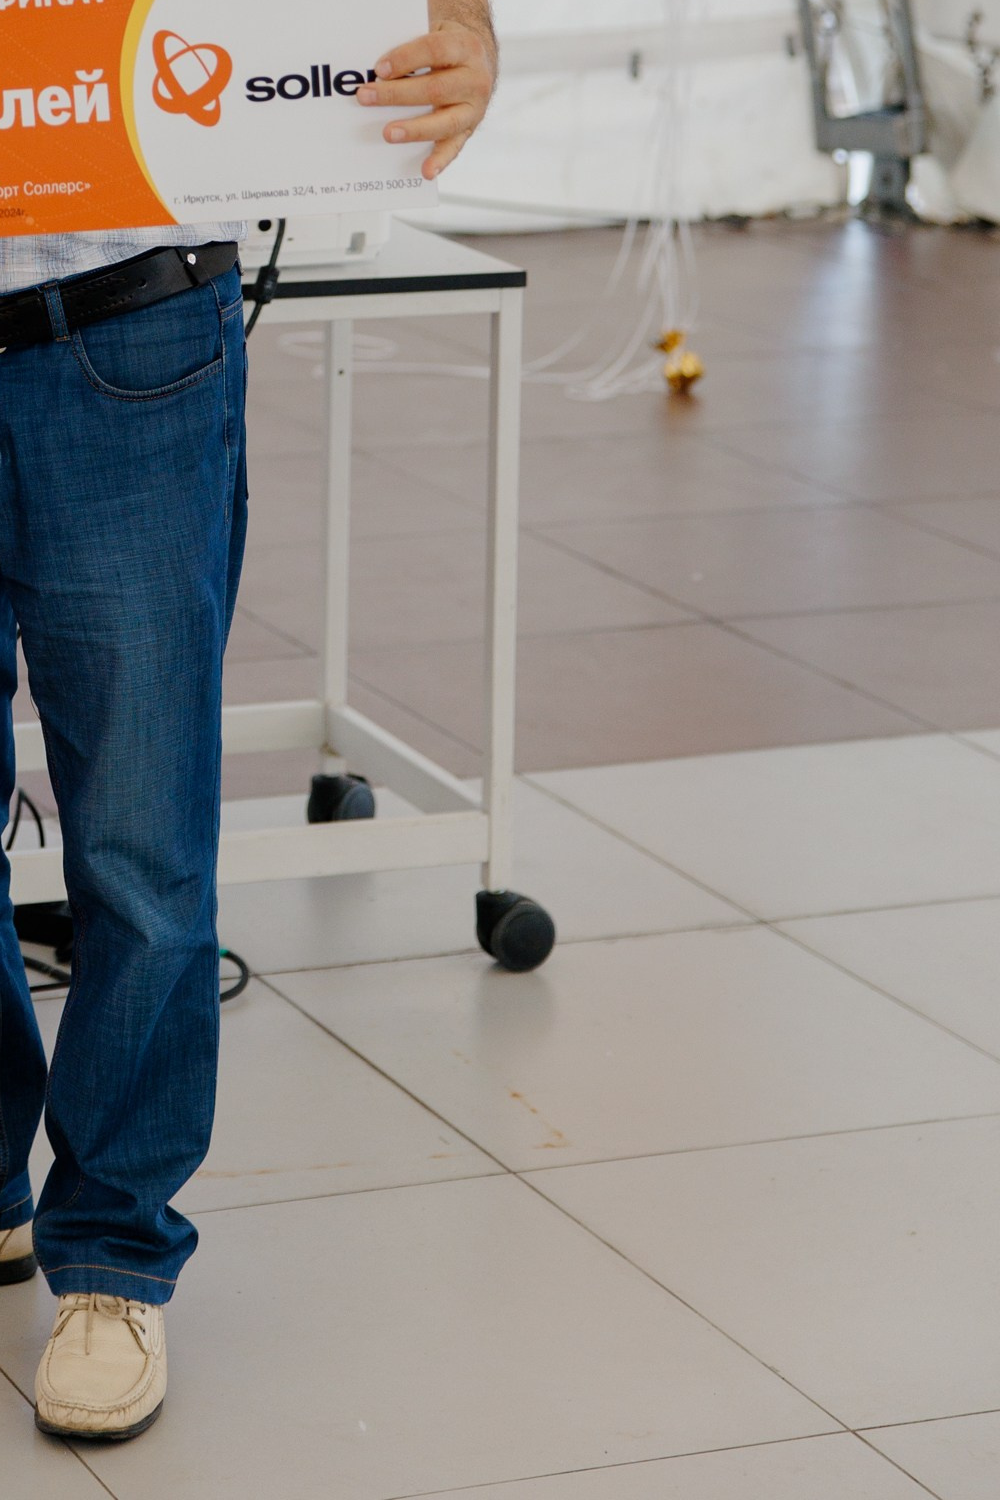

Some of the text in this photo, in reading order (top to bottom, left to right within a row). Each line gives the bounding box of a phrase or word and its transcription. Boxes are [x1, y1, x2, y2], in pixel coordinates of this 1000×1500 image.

[245, 64, 378, 102] solle
[23, 180, 91, 196] Соллерс»
[183, 193, 223, 205] Иркутск,
[225, 193, 238, 203] ул.
[241, 188, 290, 201] Ширямова
[292, 185, 318, 197] 32/4,
[353, 180, 384, 193] (3952)
[386, 178, 423, 190] 500-337
